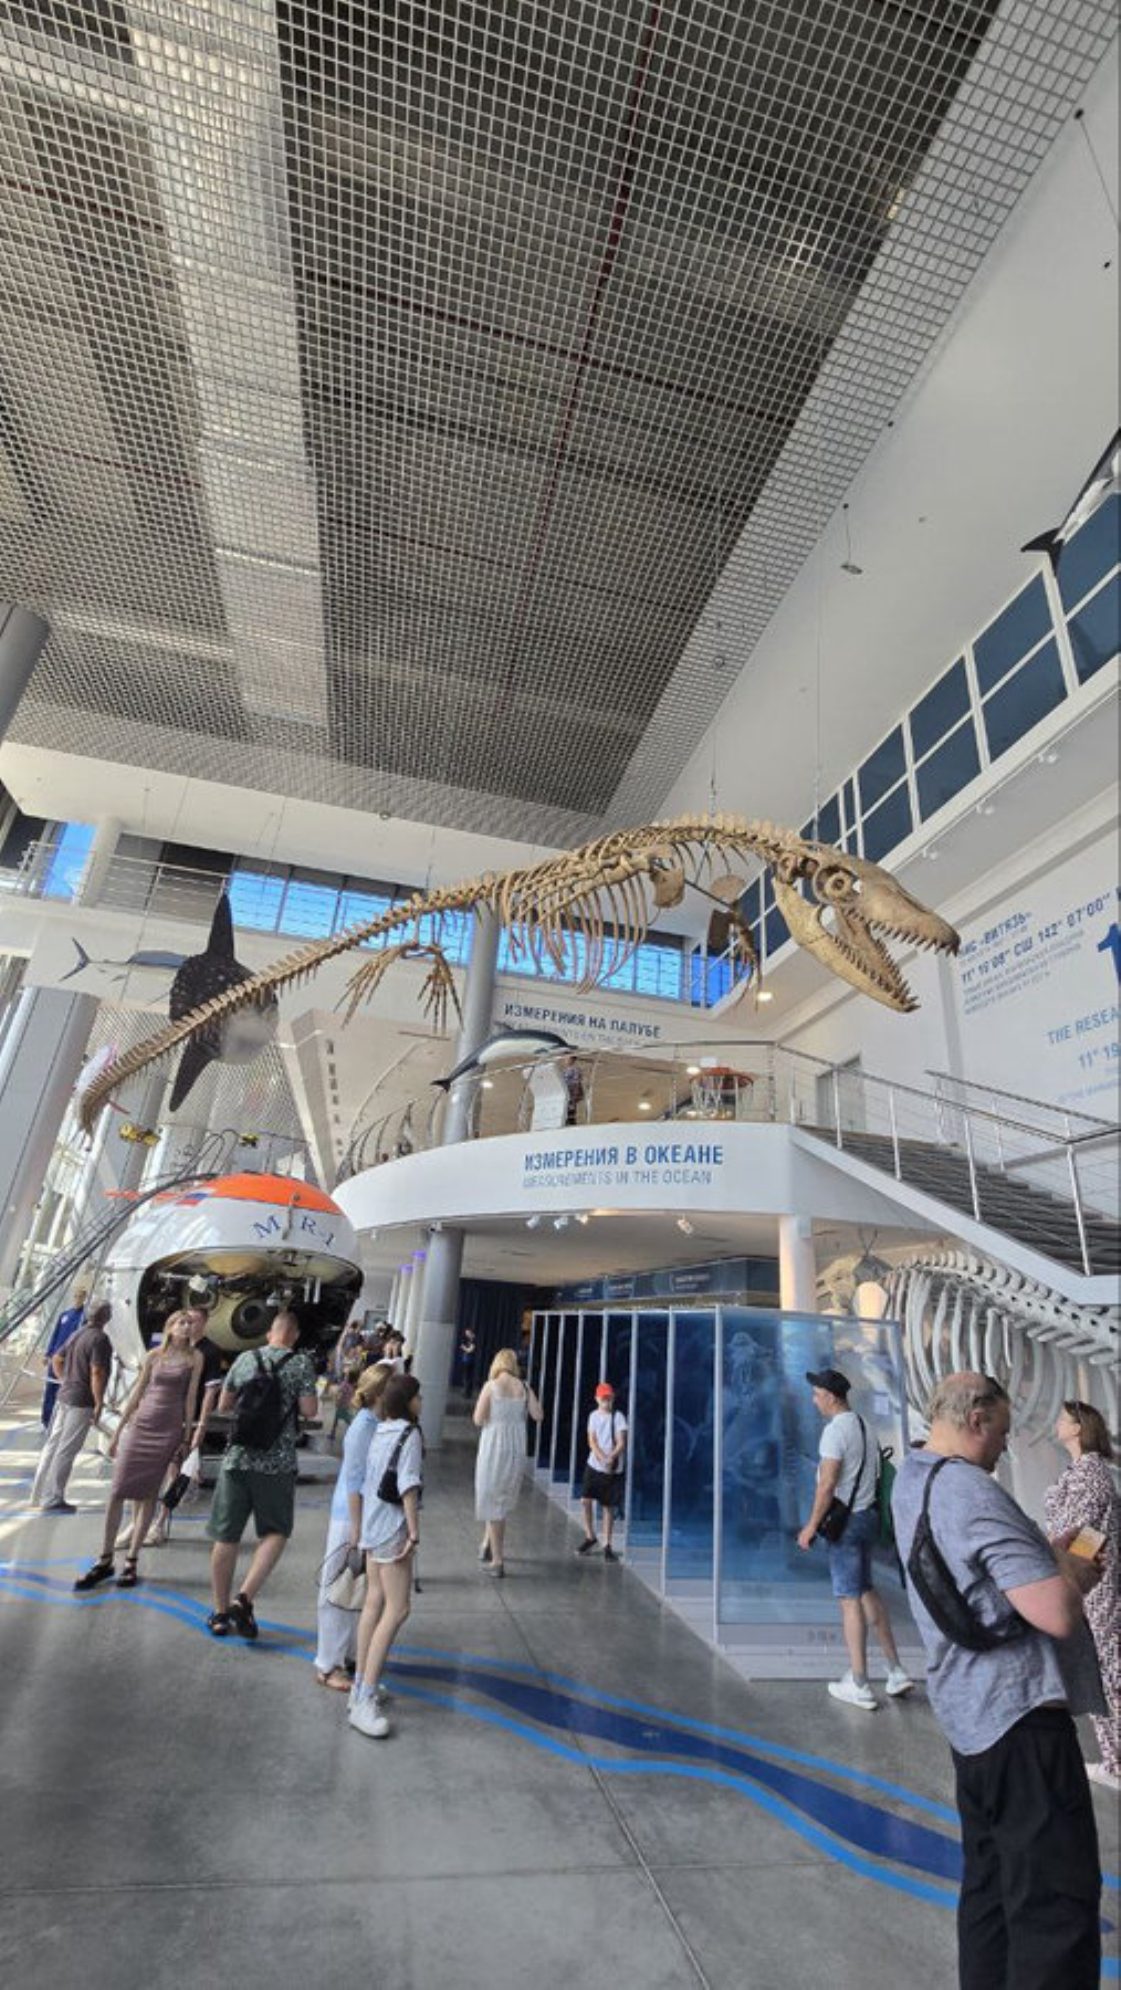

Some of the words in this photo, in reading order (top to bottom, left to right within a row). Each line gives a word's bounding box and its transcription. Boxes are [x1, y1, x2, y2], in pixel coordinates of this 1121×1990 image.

[504, 1004, 585, 1026] ИЗМЕРЕНИЯ
[588, 1016, 607, 1031] НА
[610, 1019, 662, 1039] ПАЛУБЕ
[1047, 1025, 1072, 1044] THE
[524, 1146, 619, 1171] ИЗМЕРЕНИЯ
[624, 1145, 638, 1165] В
[645, 1144, 724, 1165] ОКЕАНЕ
[634, 1169, 658, 1184] THE
[662, 1169, 712, 1185] OCEAN
